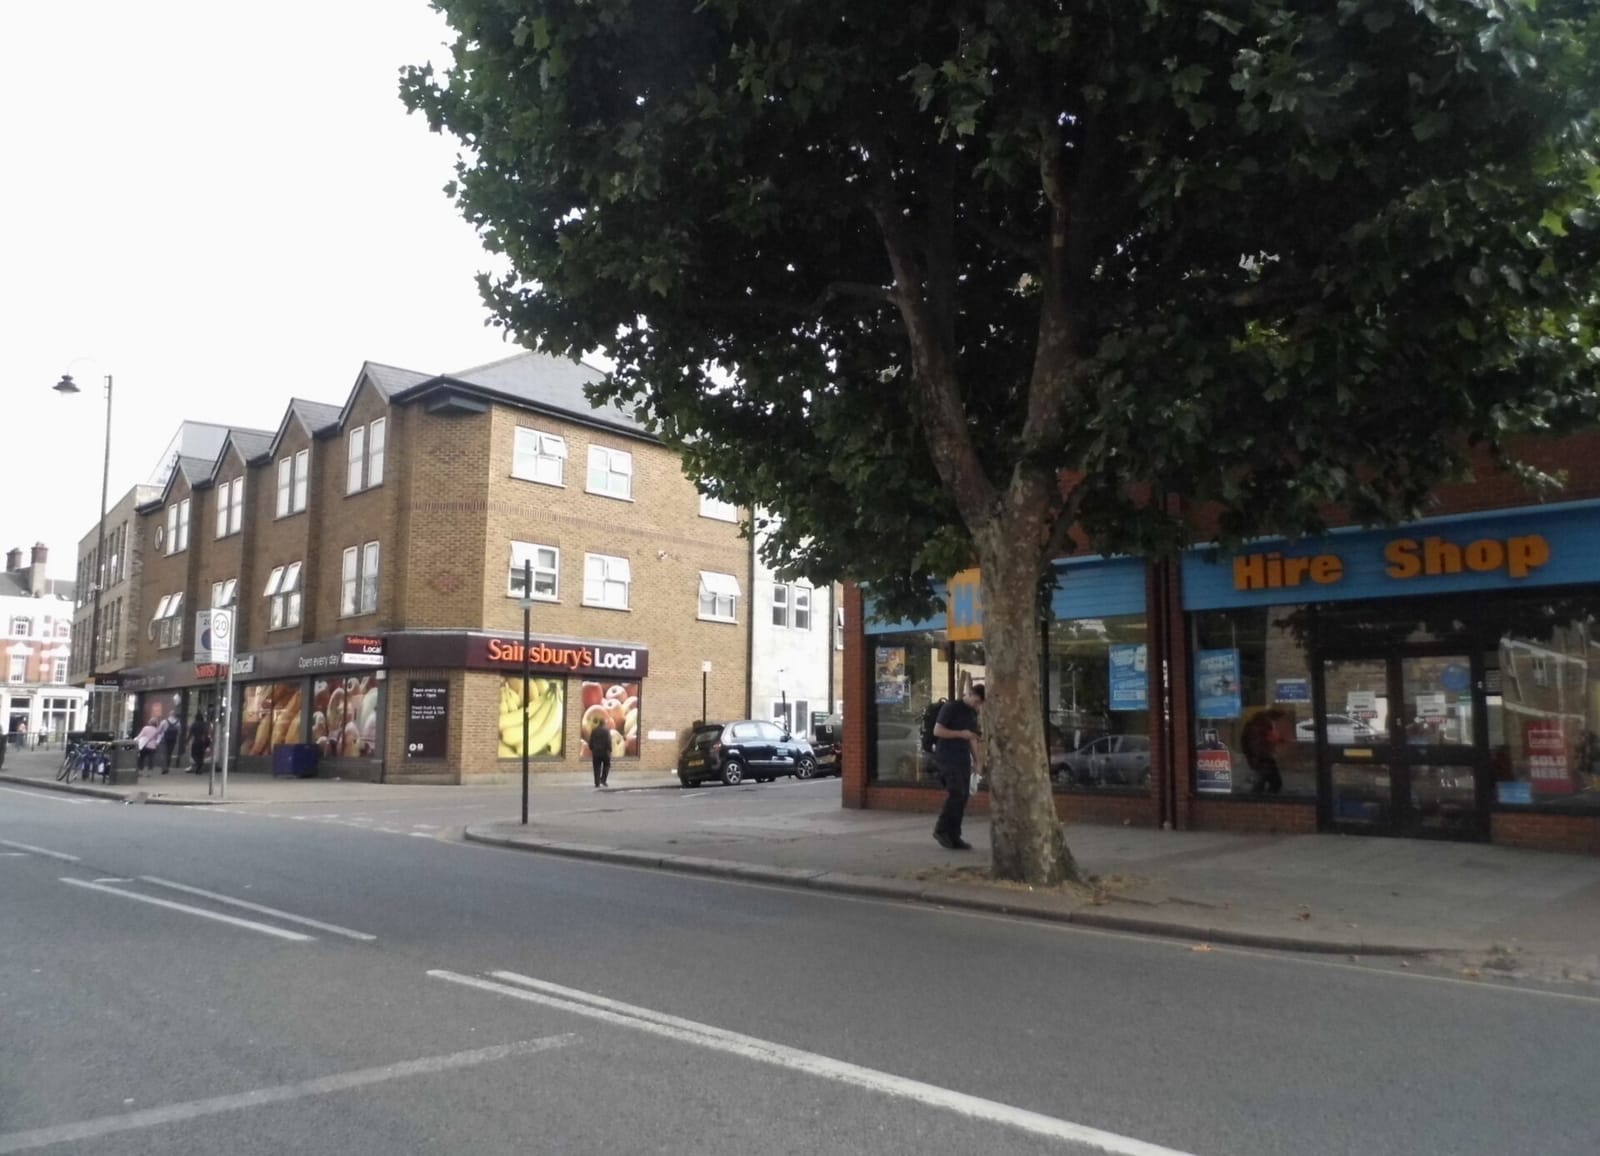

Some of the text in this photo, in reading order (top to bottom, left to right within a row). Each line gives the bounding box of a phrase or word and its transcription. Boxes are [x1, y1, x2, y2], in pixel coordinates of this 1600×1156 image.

[1232, 534, 1550, 590] Hire Shop
[214, 619, 228, 632] 20
[363, 645, 382, 654] Local
[594, 648, 636, 670] Local
[1197, 759, 1230, 771] CALOR
[1529, 755, 1567, 766] SOLD
[1530, 767, 1569, 779] HERE
